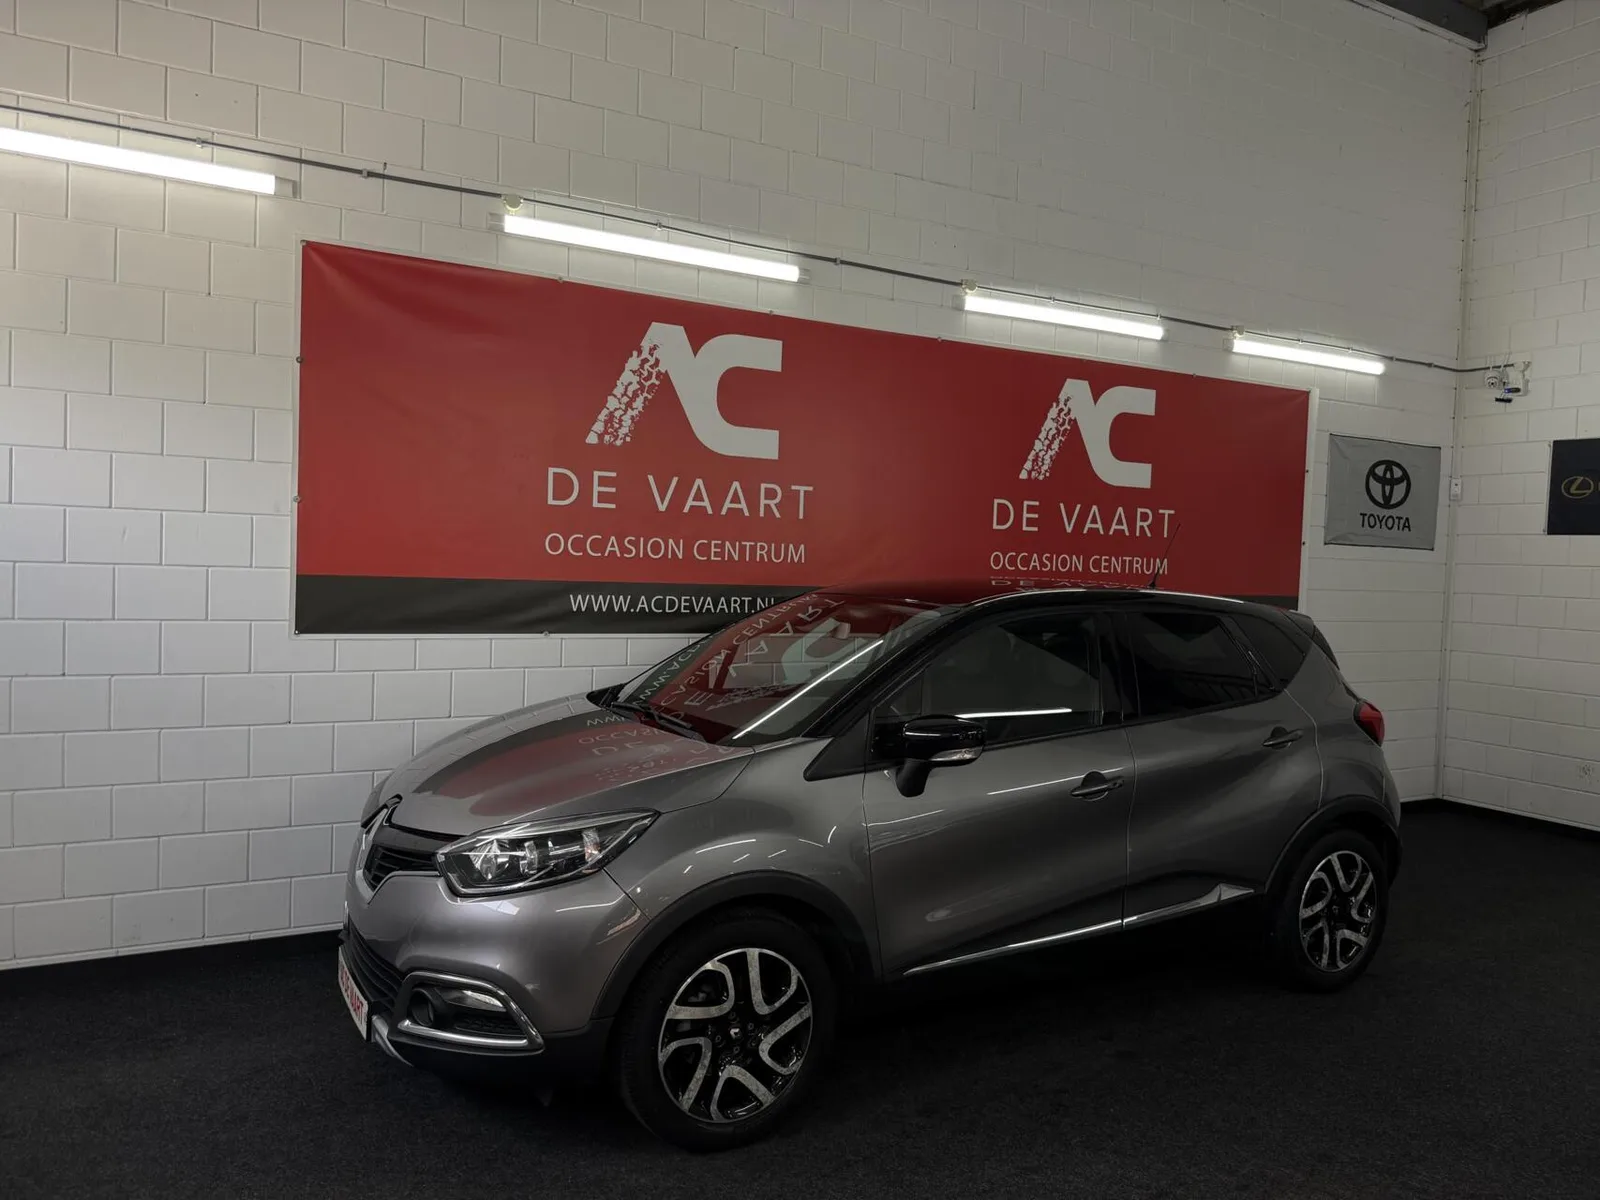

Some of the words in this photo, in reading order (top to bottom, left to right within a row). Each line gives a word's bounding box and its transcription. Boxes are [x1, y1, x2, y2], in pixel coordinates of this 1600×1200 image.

[585, 321, 783, 460] AC
[1018, 378, 1157, 489] AC
[547, 466, 617, 509] DE
[647, 474, 814, 520] VAART
[992, 498, 1040, 532] DE
[1059, 502, 1175, 538] VAART
[1359, 512, 1412, 533] TOYOTA
[544, 532, 683, 560] OCCASION
[693, 538, 805, 563] CENTRUM
[990, 551, 1083, 572] OCCASION
[1089, 555, 1168, 575] CENTRUM
